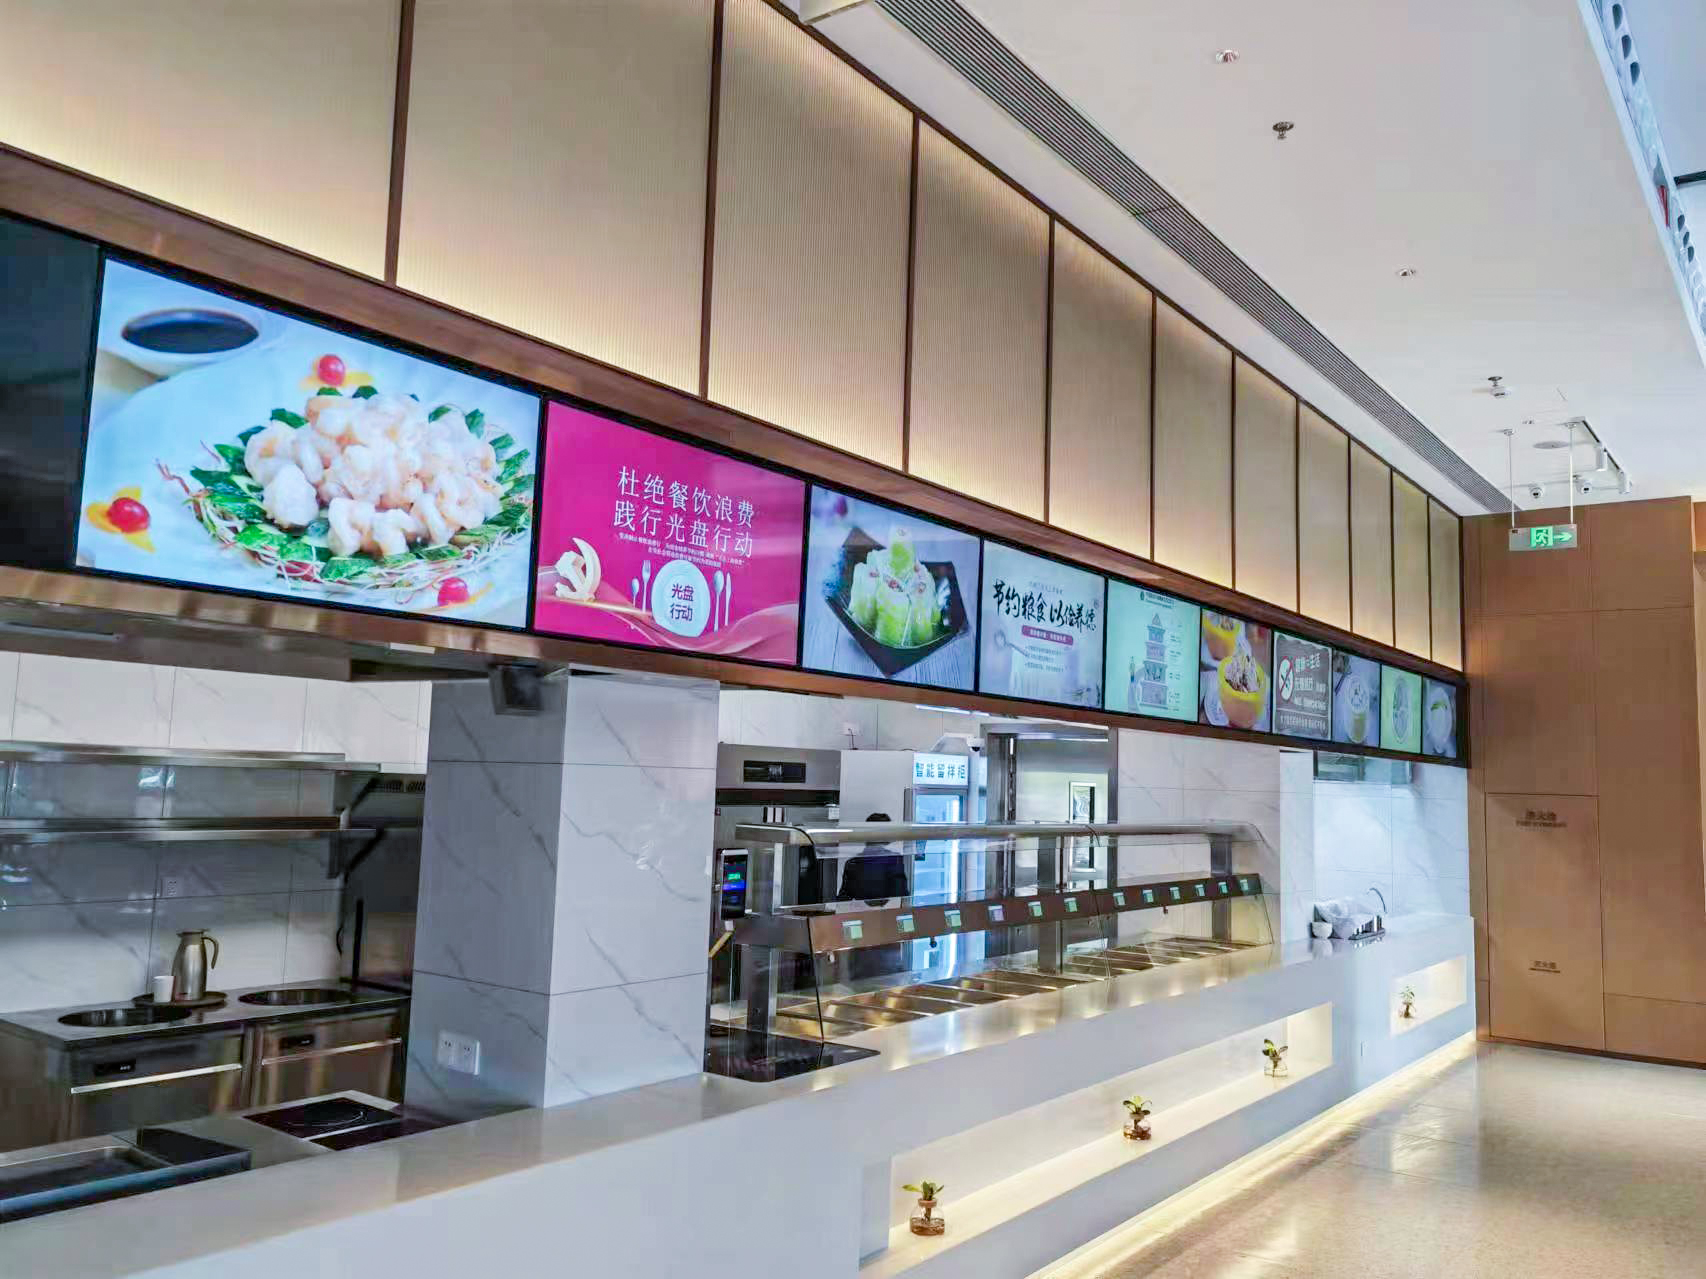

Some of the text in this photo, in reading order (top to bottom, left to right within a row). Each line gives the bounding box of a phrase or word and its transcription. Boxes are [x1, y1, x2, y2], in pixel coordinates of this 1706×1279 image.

[617, 467, 755, 528] 杜绝餐饮浪费
[613, 501, 754, 558] 践行光盘行动
[671, 584, 694, 602] 光盘
[670, 603, 693, 621] 行动
